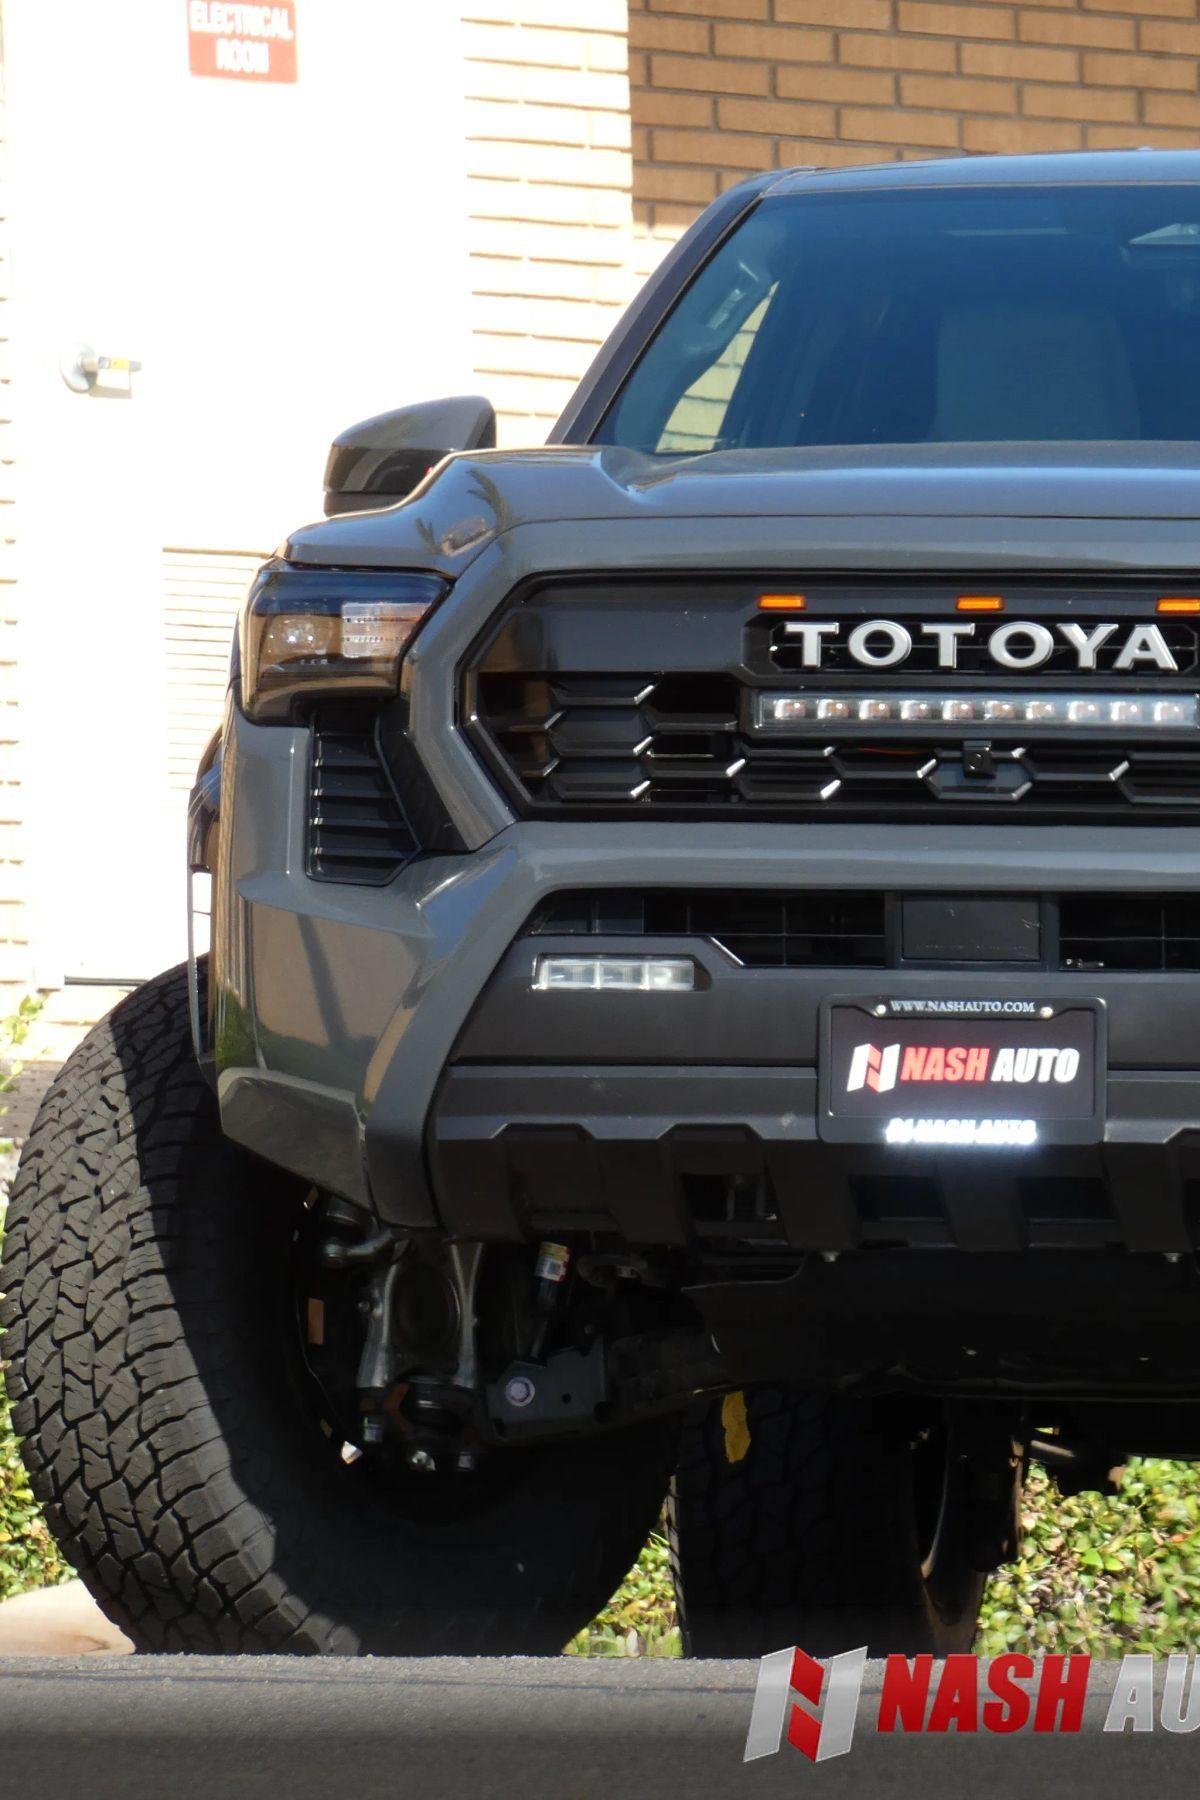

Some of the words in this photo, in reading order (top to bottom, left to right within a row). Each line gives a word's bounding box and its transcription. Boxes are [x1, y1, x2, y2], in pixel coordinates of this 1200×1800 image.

[190, 1, 294, 40] ELECTRICAL
[784, 620, 1178, 671] TOTOYA
[890, 1000, 1035, 1014] WWW.NASHAUTO.COM
[900, 1047, 990, 1082] NASH
[990, 1048, 1080, 1083] AUTO
